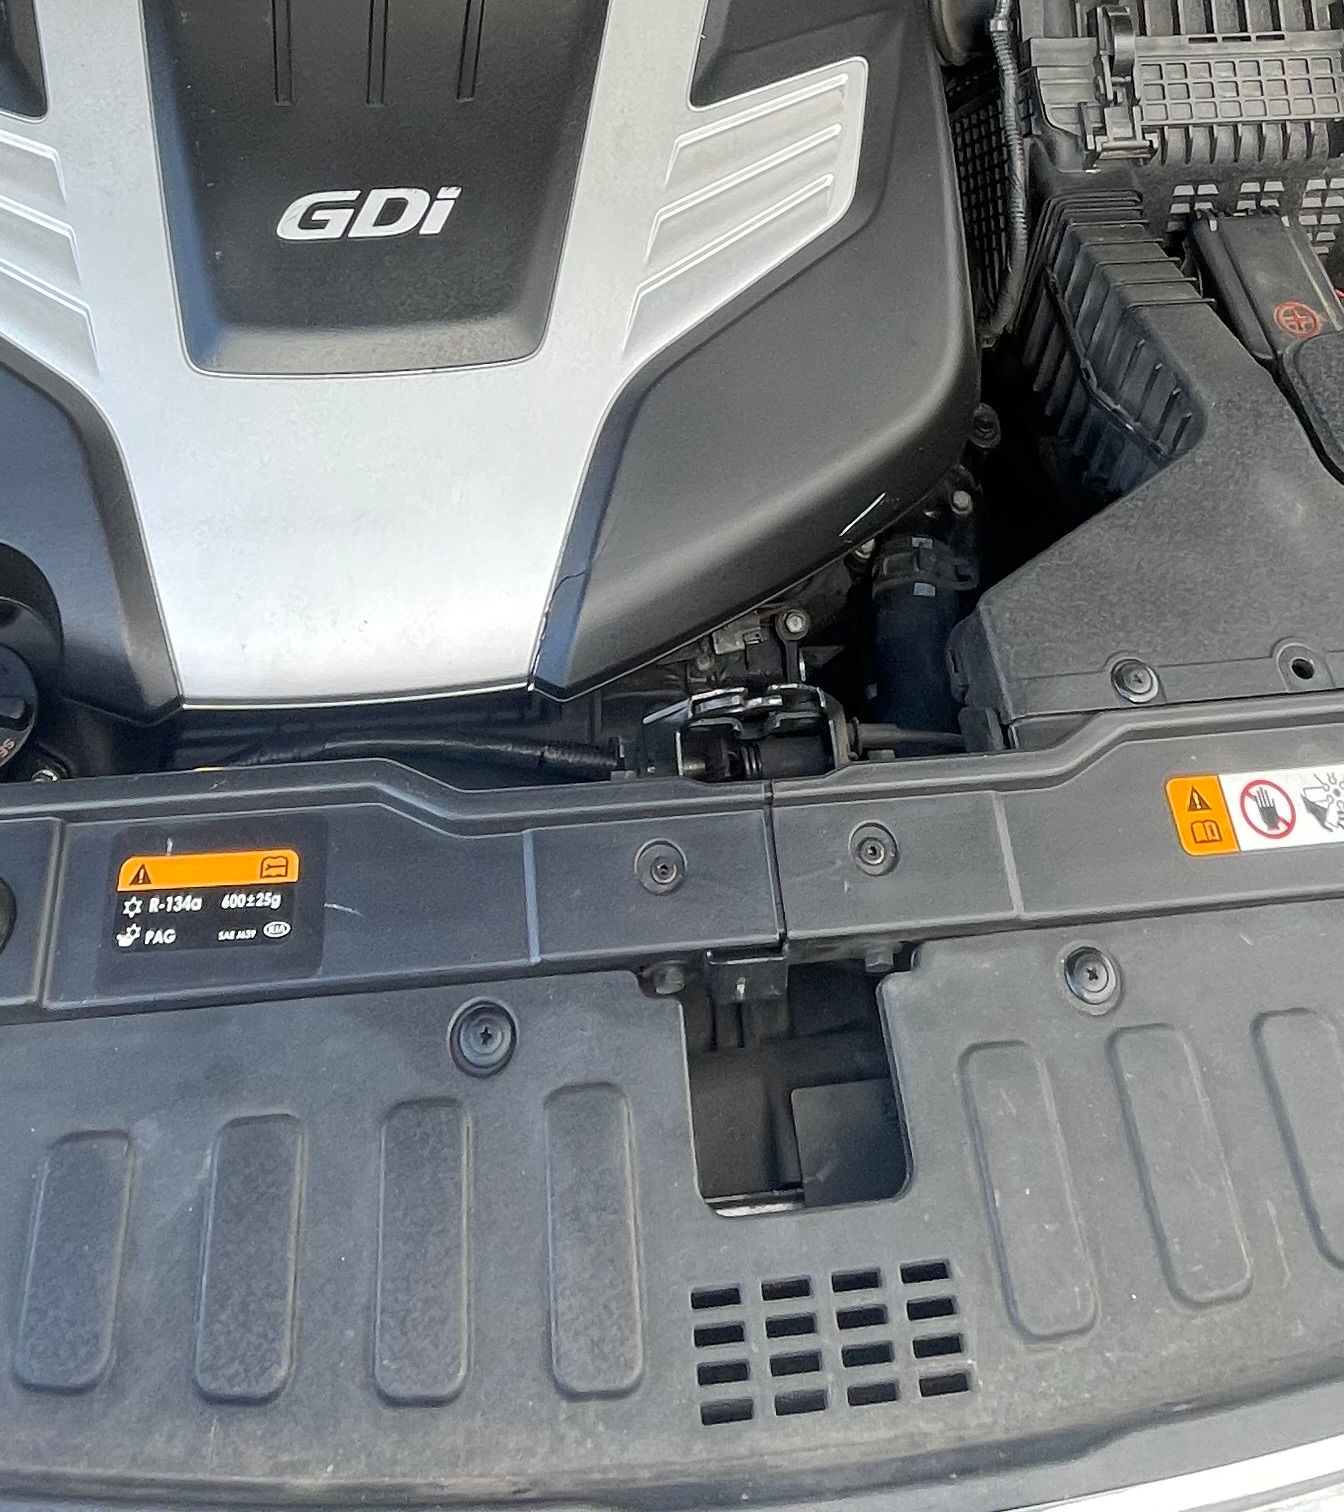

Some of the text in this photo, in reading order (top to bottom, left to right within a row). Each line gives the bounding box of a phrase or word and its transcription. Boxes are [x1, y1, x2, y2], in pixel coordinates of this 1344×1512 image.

[276, 186, 463, 241] GDi
[148, 891, 282, 913] R-134a 600±25g
[143, 927, 177, 946] PAG
